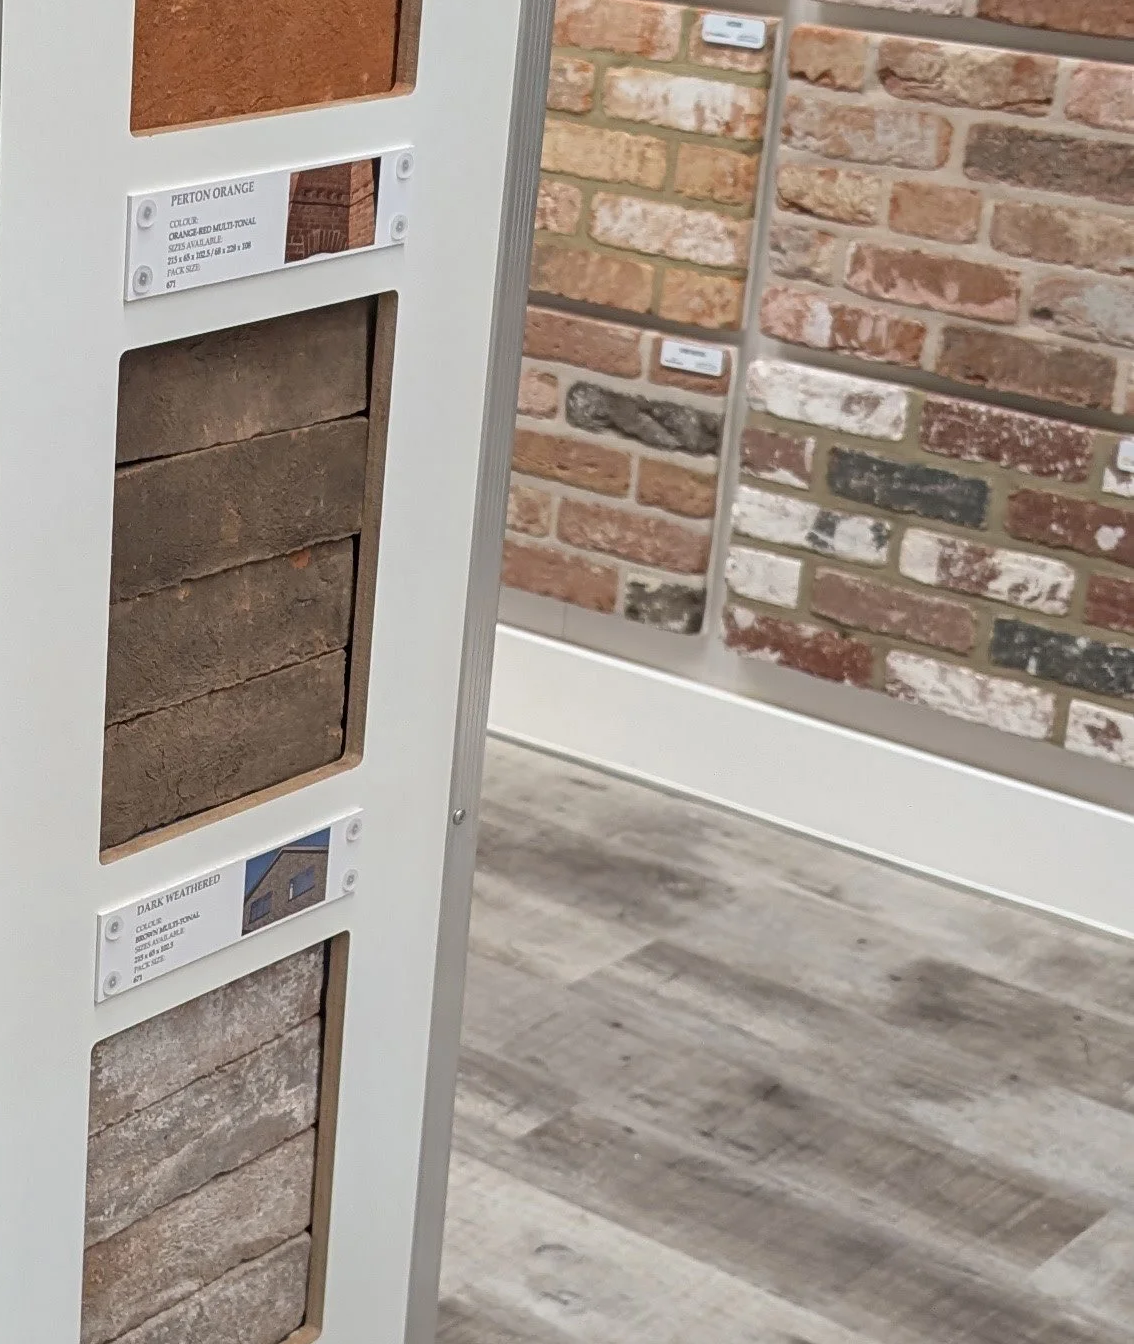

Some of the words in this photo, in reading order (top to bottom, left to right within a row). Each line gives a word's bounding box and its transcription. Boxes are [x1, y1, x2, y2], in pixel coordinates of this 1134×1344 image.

[171, 189, 210, 206] PERTON
[213, 181, 254, 198] ORANGE
[169, 226, 212, 241] ORANGE-RED
[213, 217, 256, 232] MULTI-TONAL
[168, 242, 185, 253] SIZES
[137, 896, 164, 916] DARK
[166, 874, 220, 904] WEATHERED
